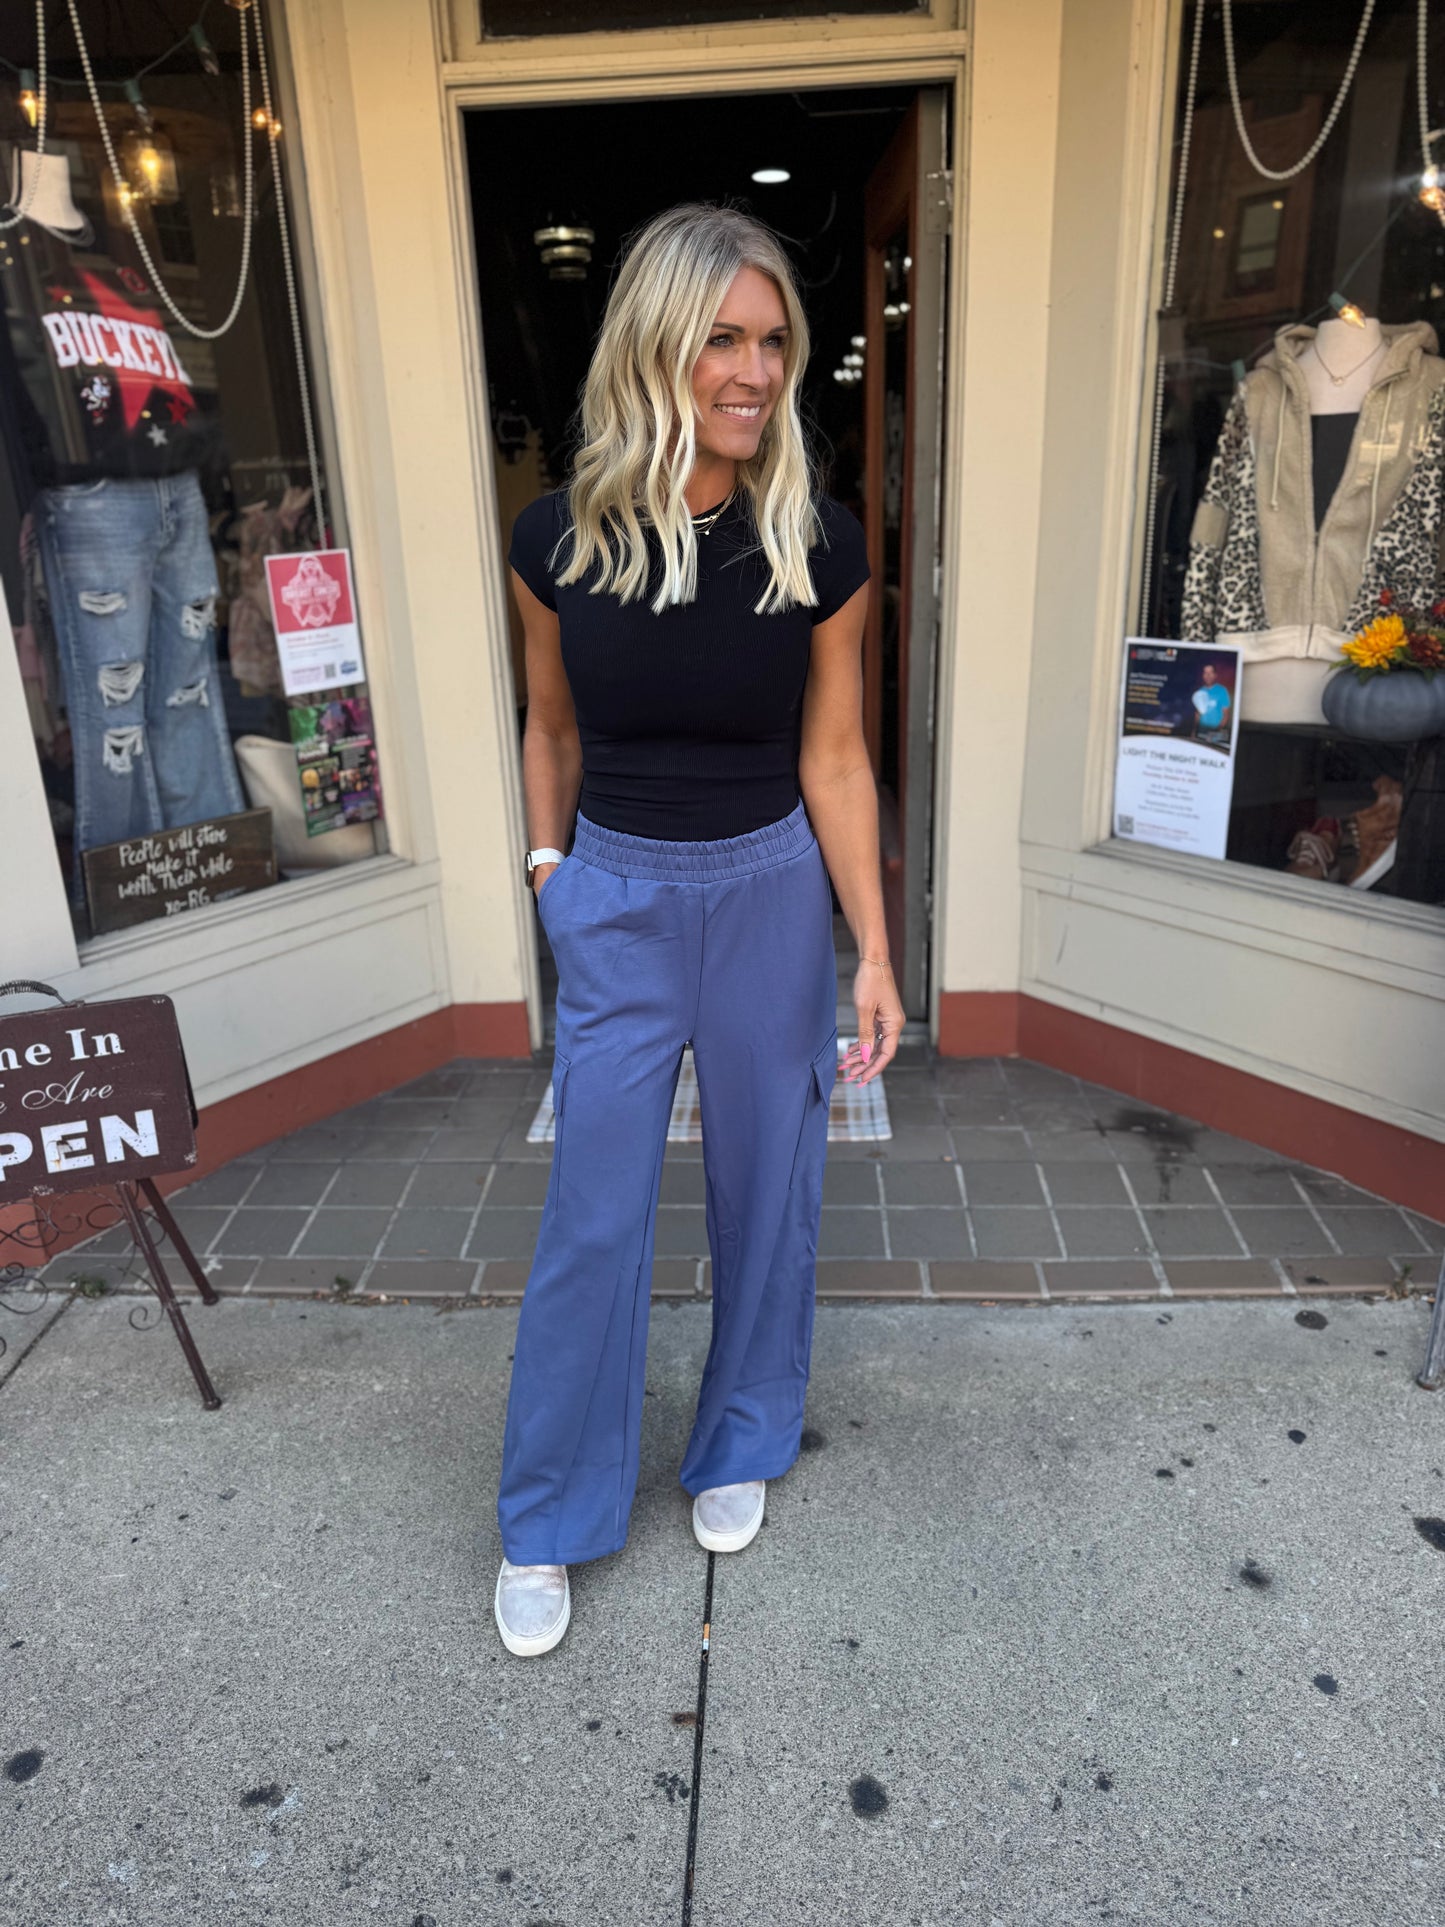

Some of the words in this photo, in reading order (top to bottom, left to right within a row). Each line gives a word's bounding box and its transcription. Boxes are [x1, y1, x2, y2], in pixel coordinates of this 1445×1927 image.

[1122, 747, 1148, 758] LIGHT
[1150, 750, 1166, 760] THE
[1169, 753, 1197, 765] NIGHT
[1199, 758, 1227, 769] WALK
[65, 1028, 125, 1061] In
[22, 1071, 114, 1110] Are
